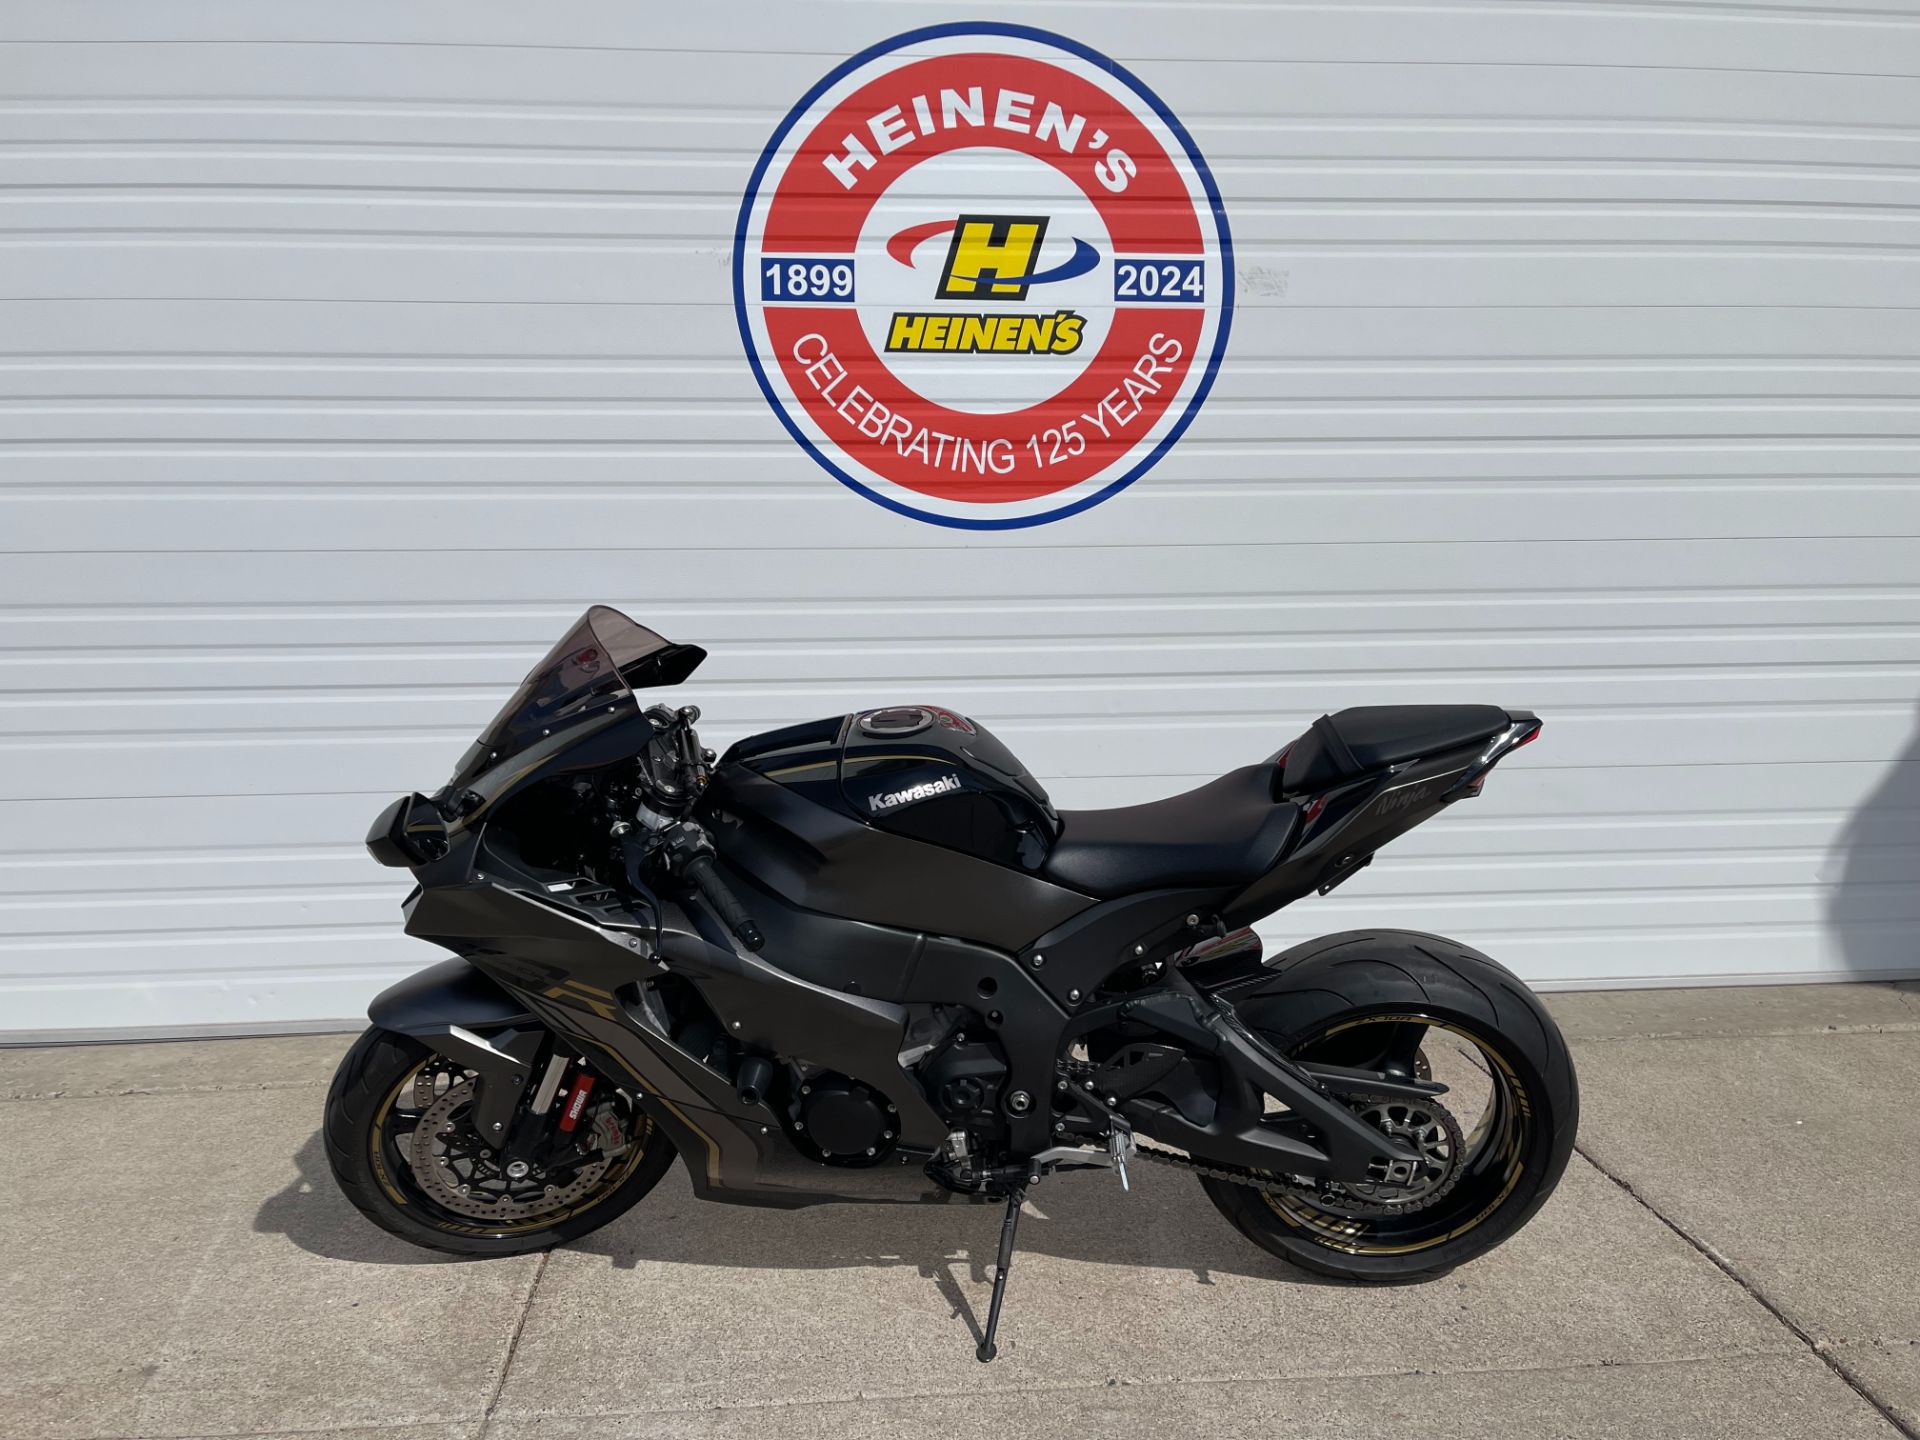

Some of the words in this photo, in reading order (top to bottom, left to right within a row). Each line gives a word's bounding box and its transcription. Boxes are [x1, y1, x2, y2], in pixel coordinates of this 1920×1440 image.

[822, 87, 1136, 192] HEINEN'S
[765, 263, 854, 297] 1899
[1117, 265, 1204, 297] 2024
[887, 312, 1085, 353] HEINEN'S
[793, 332, 1015, 474] CELEBRATING
[1025, 425, 1086, 469] 125
[1081, 332, 1182, 439] YEARS
[868, 773, 961, 811] Kawasaki
[1375, 783, 1431, 816] Ninja
[568, 1089, 588, 1120] SHOWA
